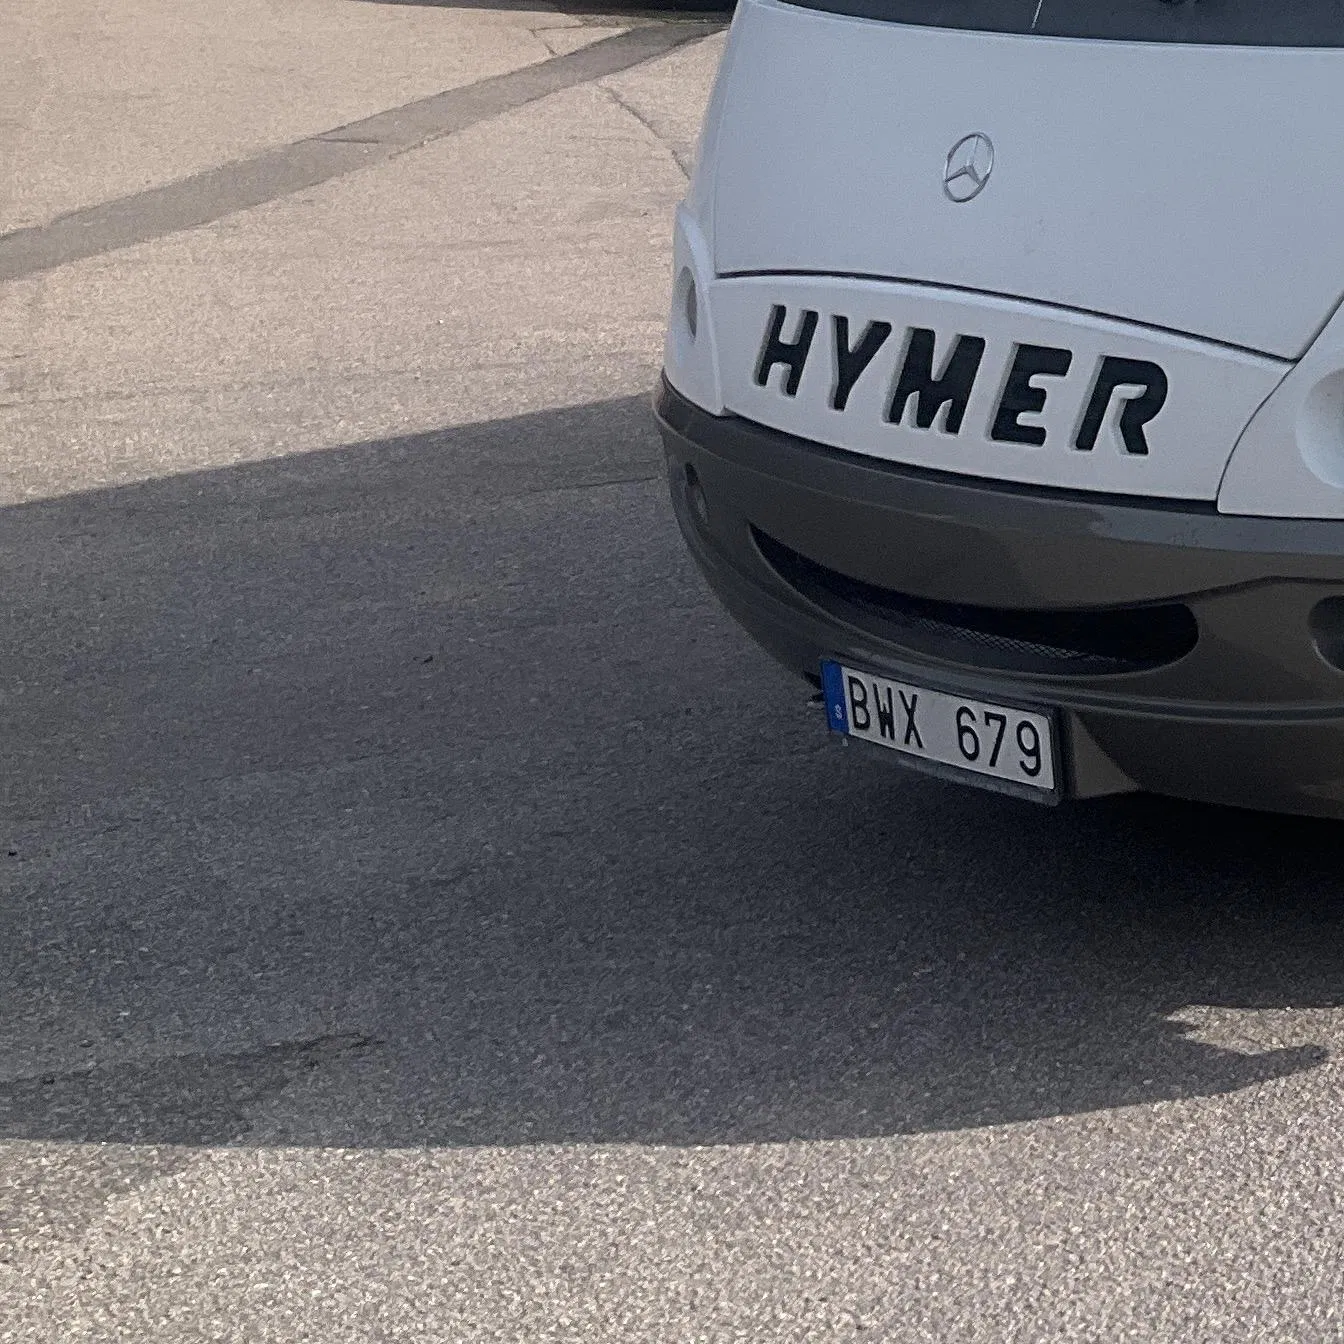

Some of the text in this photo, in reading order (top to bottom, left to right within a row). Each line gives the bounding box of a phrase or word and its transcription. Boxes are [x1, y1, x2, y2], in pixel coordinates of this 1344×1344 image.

[753, 303, 1169, 456] HYMER
[847, 675, 1042, 777] BWX 679
